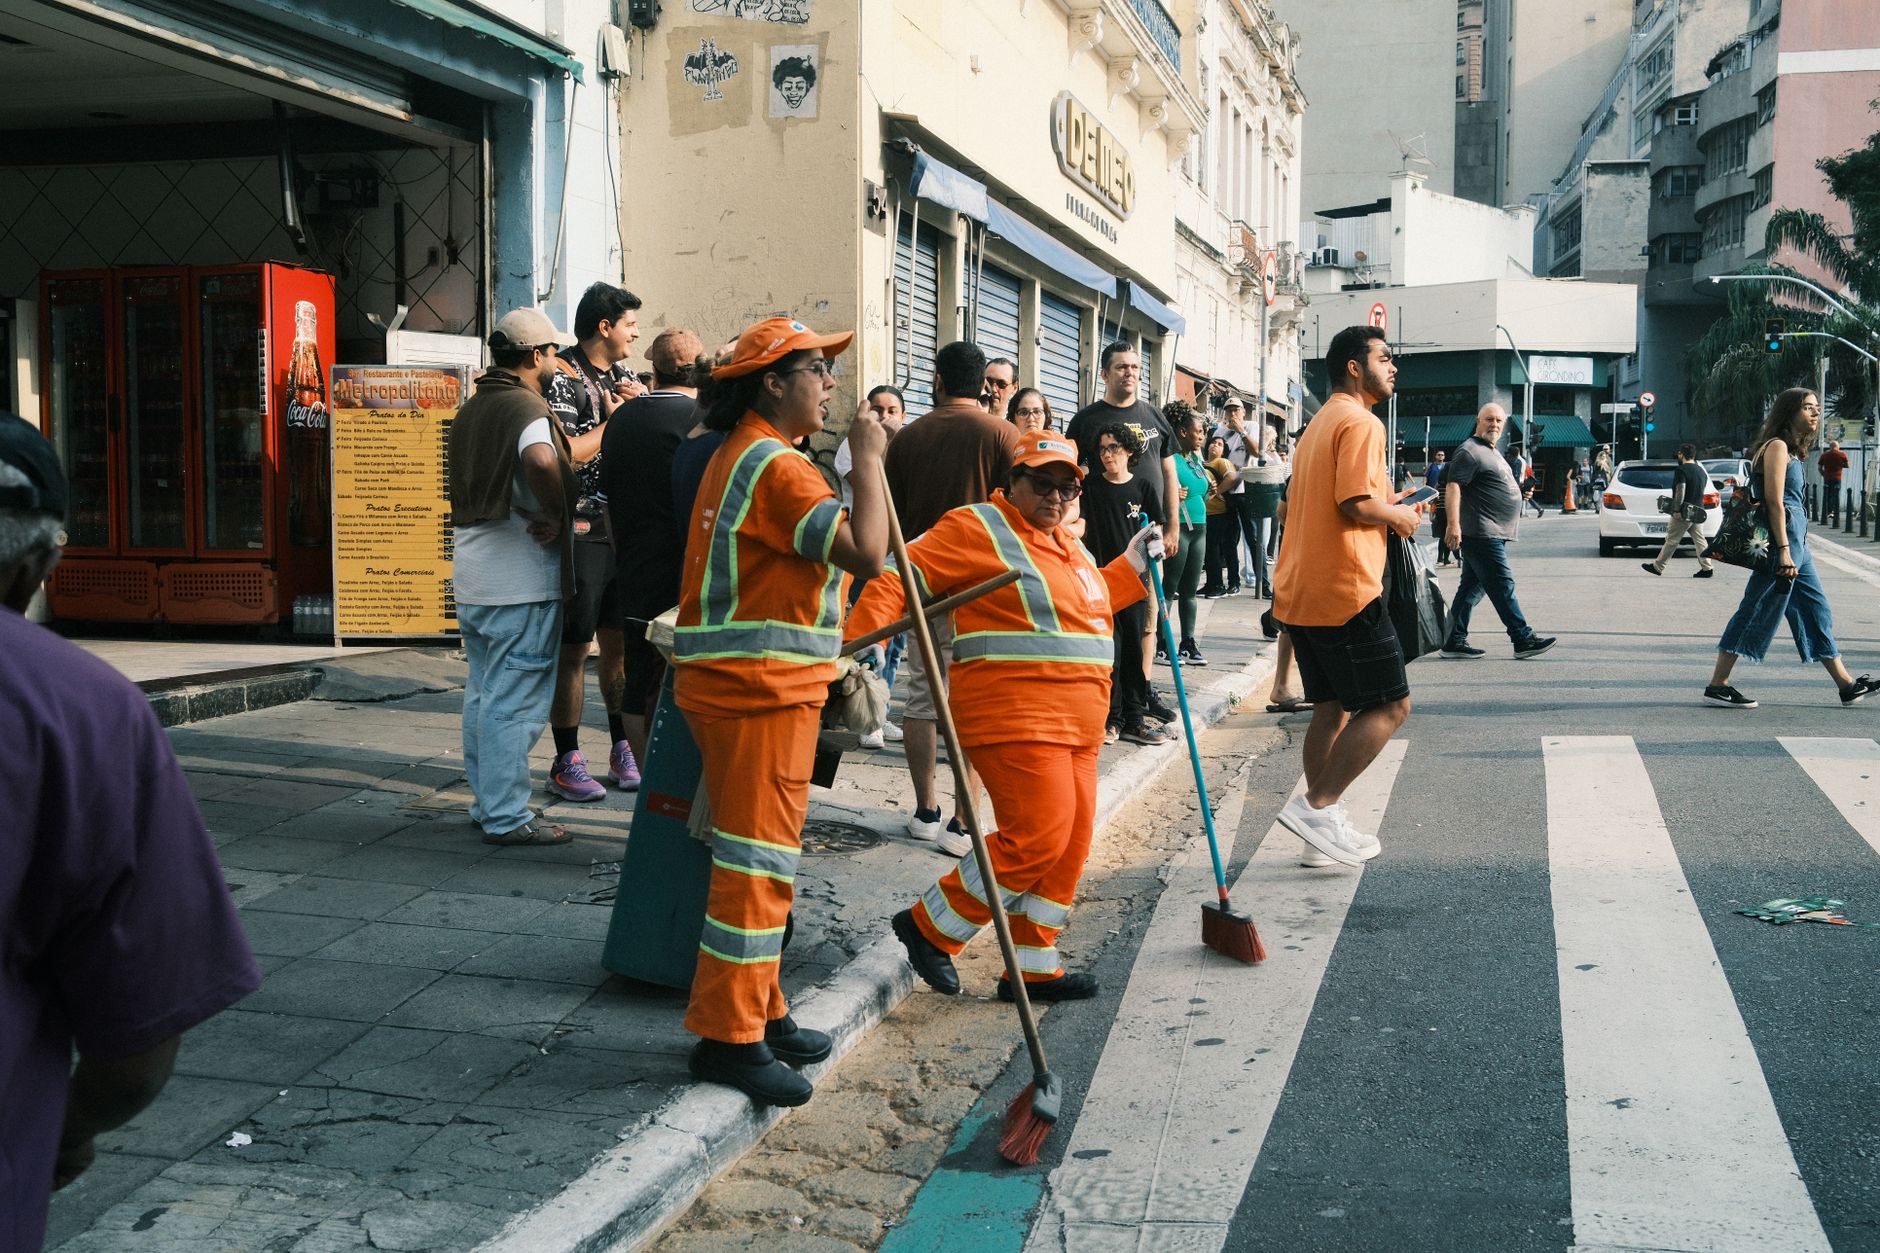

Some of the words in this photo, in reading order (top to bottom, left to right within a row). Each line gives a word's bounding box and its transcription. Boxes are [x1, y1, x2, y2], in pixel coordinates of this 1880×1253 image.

[1066, 98, 1134, 213] DEMEO
[363, 369, 403, 378] Restaurante
[287, 399, 327, 428] Coca-Cola
[368, 410, 394, 418] Pratos
[410, 410, 424, 418] Dia
[365, 504, 390, 512] Pratos
[394, 504, 432, 512] Executivos
[393, 568, 434, 576] Comerciais
